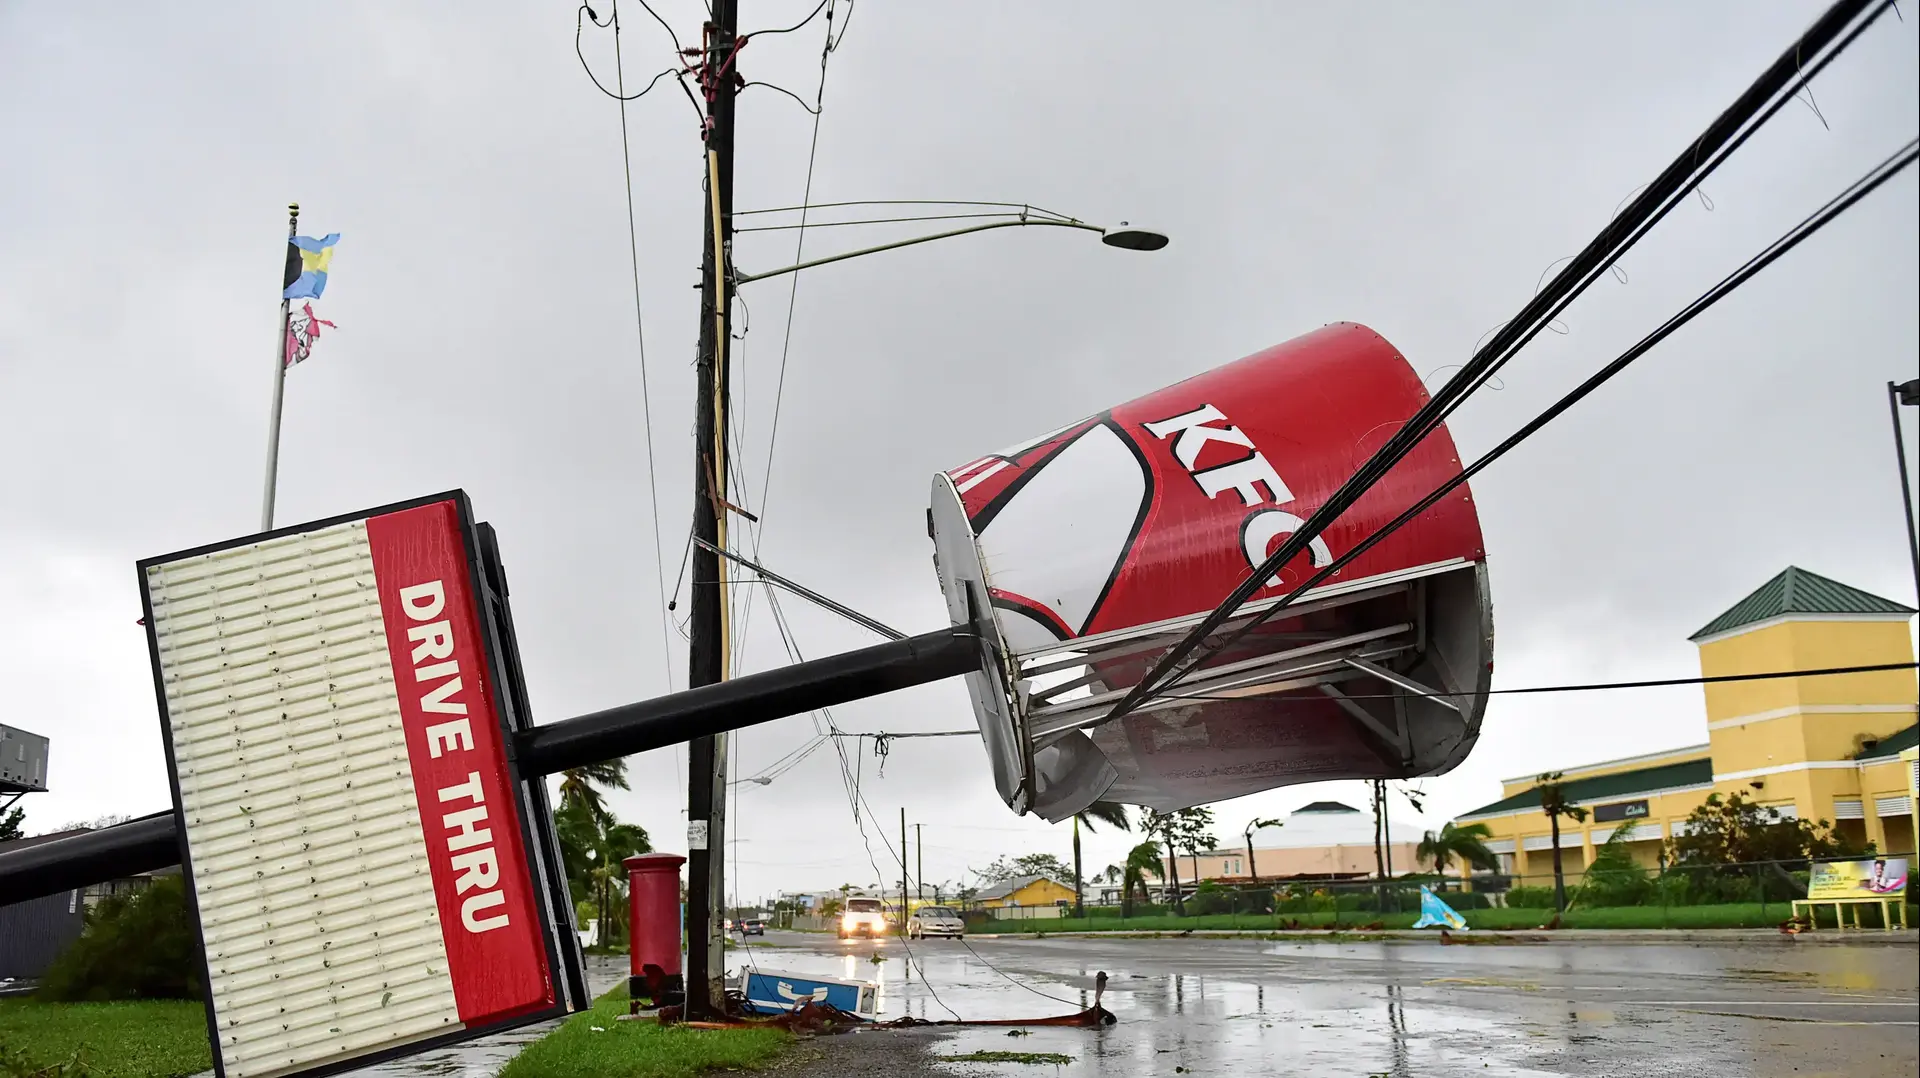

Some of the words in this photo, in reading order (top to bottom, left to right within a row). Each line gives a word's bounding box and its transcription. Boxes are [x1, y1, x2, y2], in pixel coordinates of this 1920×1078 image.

[1139, 403, 1334, 588] KFC
[400, 580, 475, 759] DRIVE
[438, 771, 510, 934] THRU
